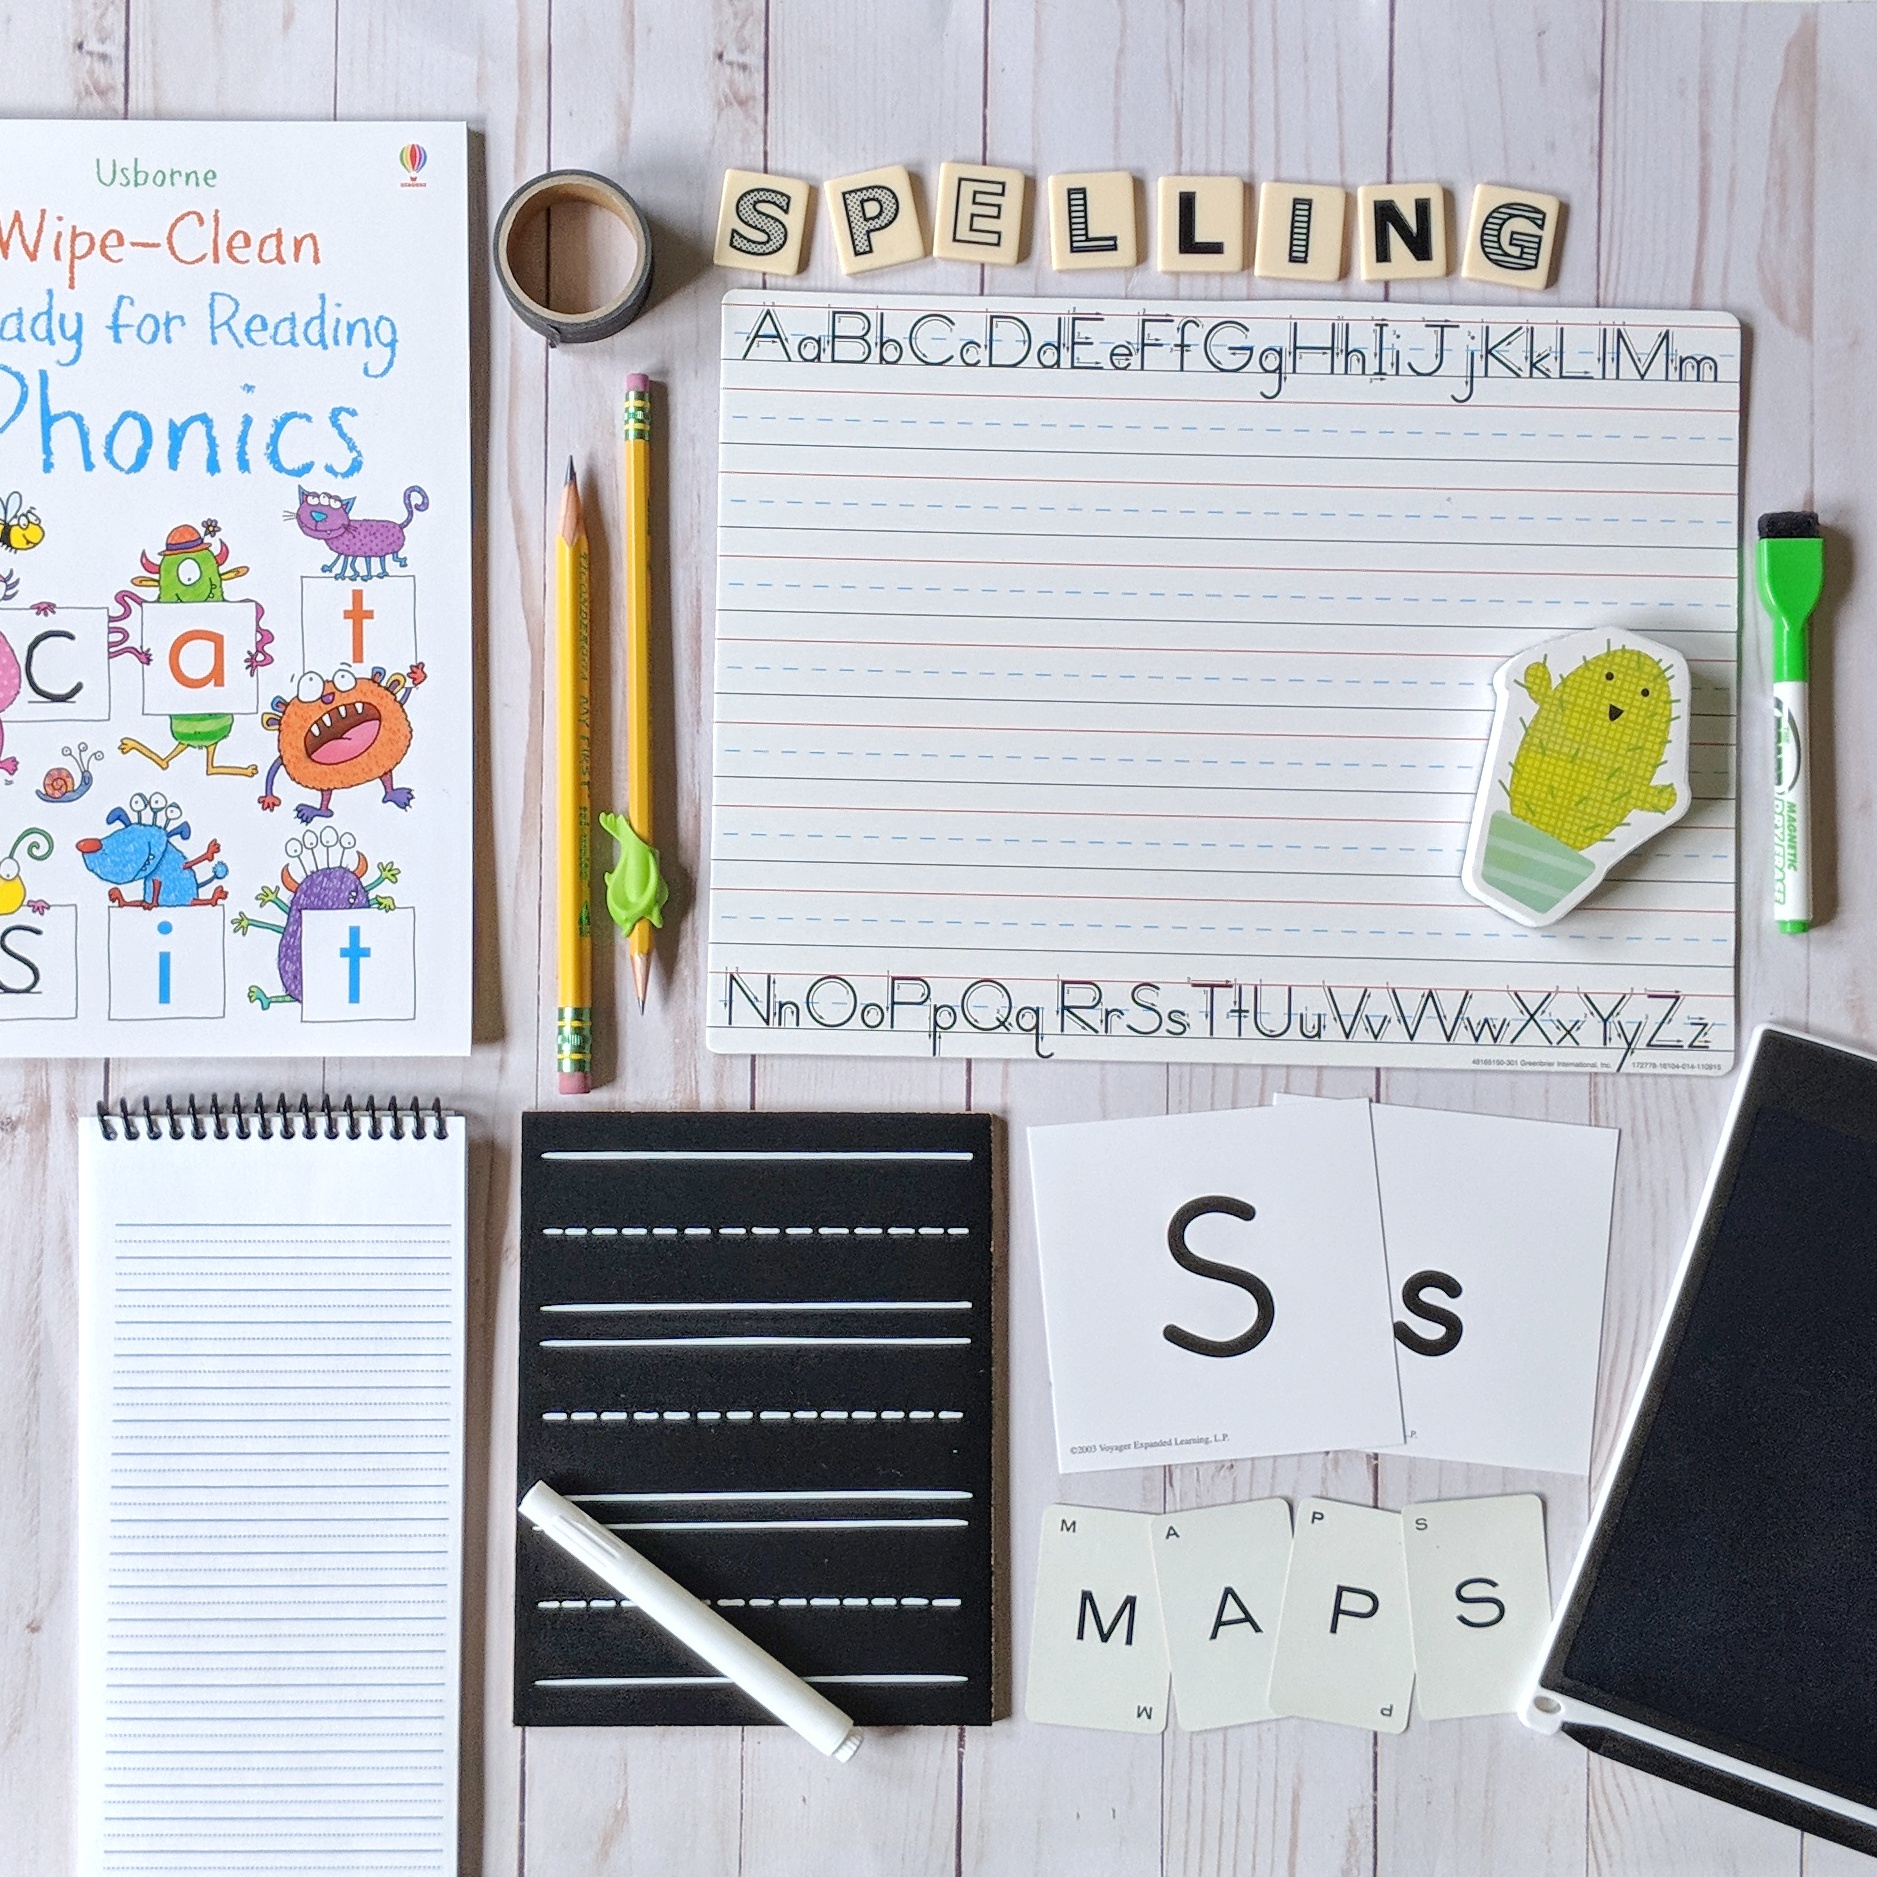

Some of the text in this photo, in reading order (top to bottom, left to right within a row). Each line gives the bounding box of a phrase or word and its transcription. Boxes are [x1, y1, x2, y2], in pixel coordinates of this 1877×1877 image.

[95, 157, 218, 188] Usborne
[0, 208, 322, 290] Wipe-Clean
[729, 177, 1547, 271] SPELLING
[105, 294, 186, 345] for
[209, 291, 399, 379] Reading
[1787, 801, 1798, 872] MAGNETIC
[1163, 1195, 1275, 1358] S
[1393, 1270, 1463, 1357] s
[1099, 1442, 1132, 1453] Voyager
[1133, 1438, 1172, 1450] Expanded
[1174, 1435, 1213, 1446] Learning,
[1213, 1433, 1230, 1443] L.P.
